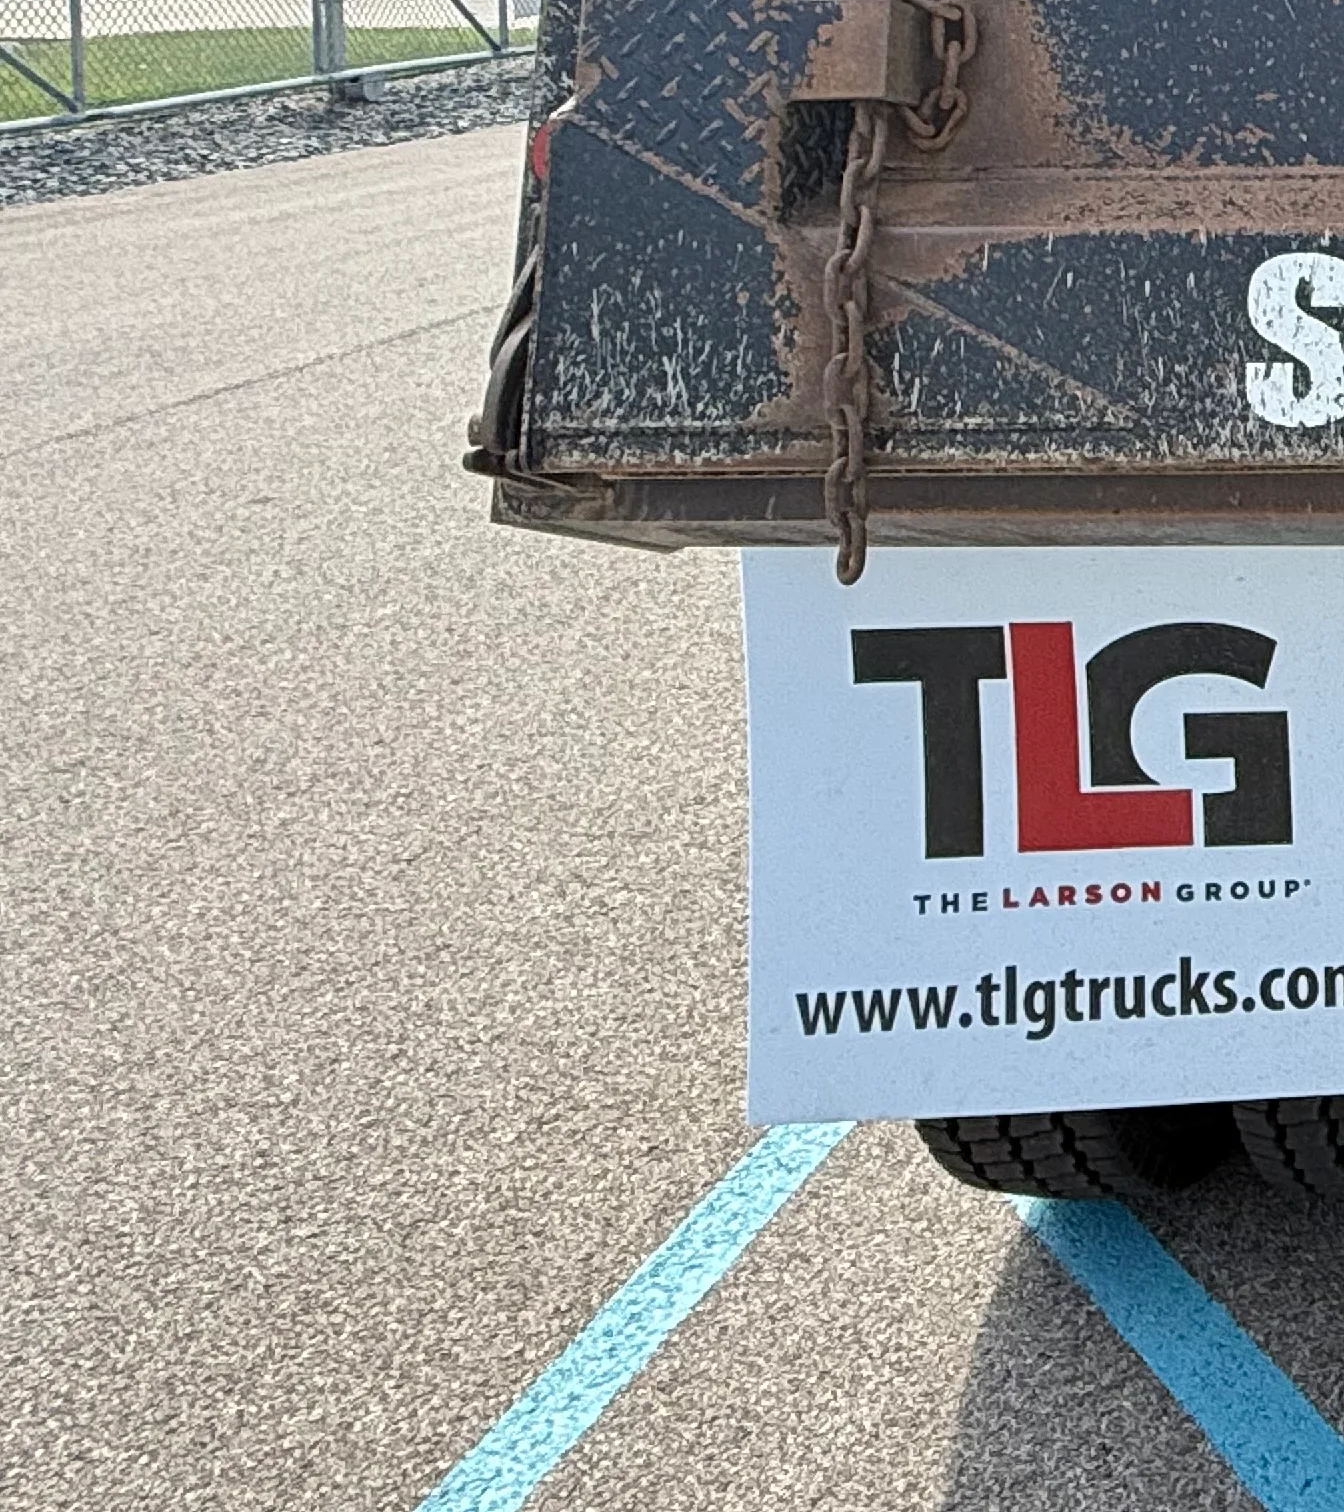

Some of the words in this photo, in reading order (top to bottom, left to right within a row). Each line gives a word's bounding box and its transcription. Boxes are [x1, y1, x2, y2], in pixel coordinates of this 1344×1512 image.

[850, 621, 1294, 860] TLG
[912, 891, 989, 915] THE
[1001, 880, 1162, 909] LARSON
[1175, 879, 1301, 903] GROUP
